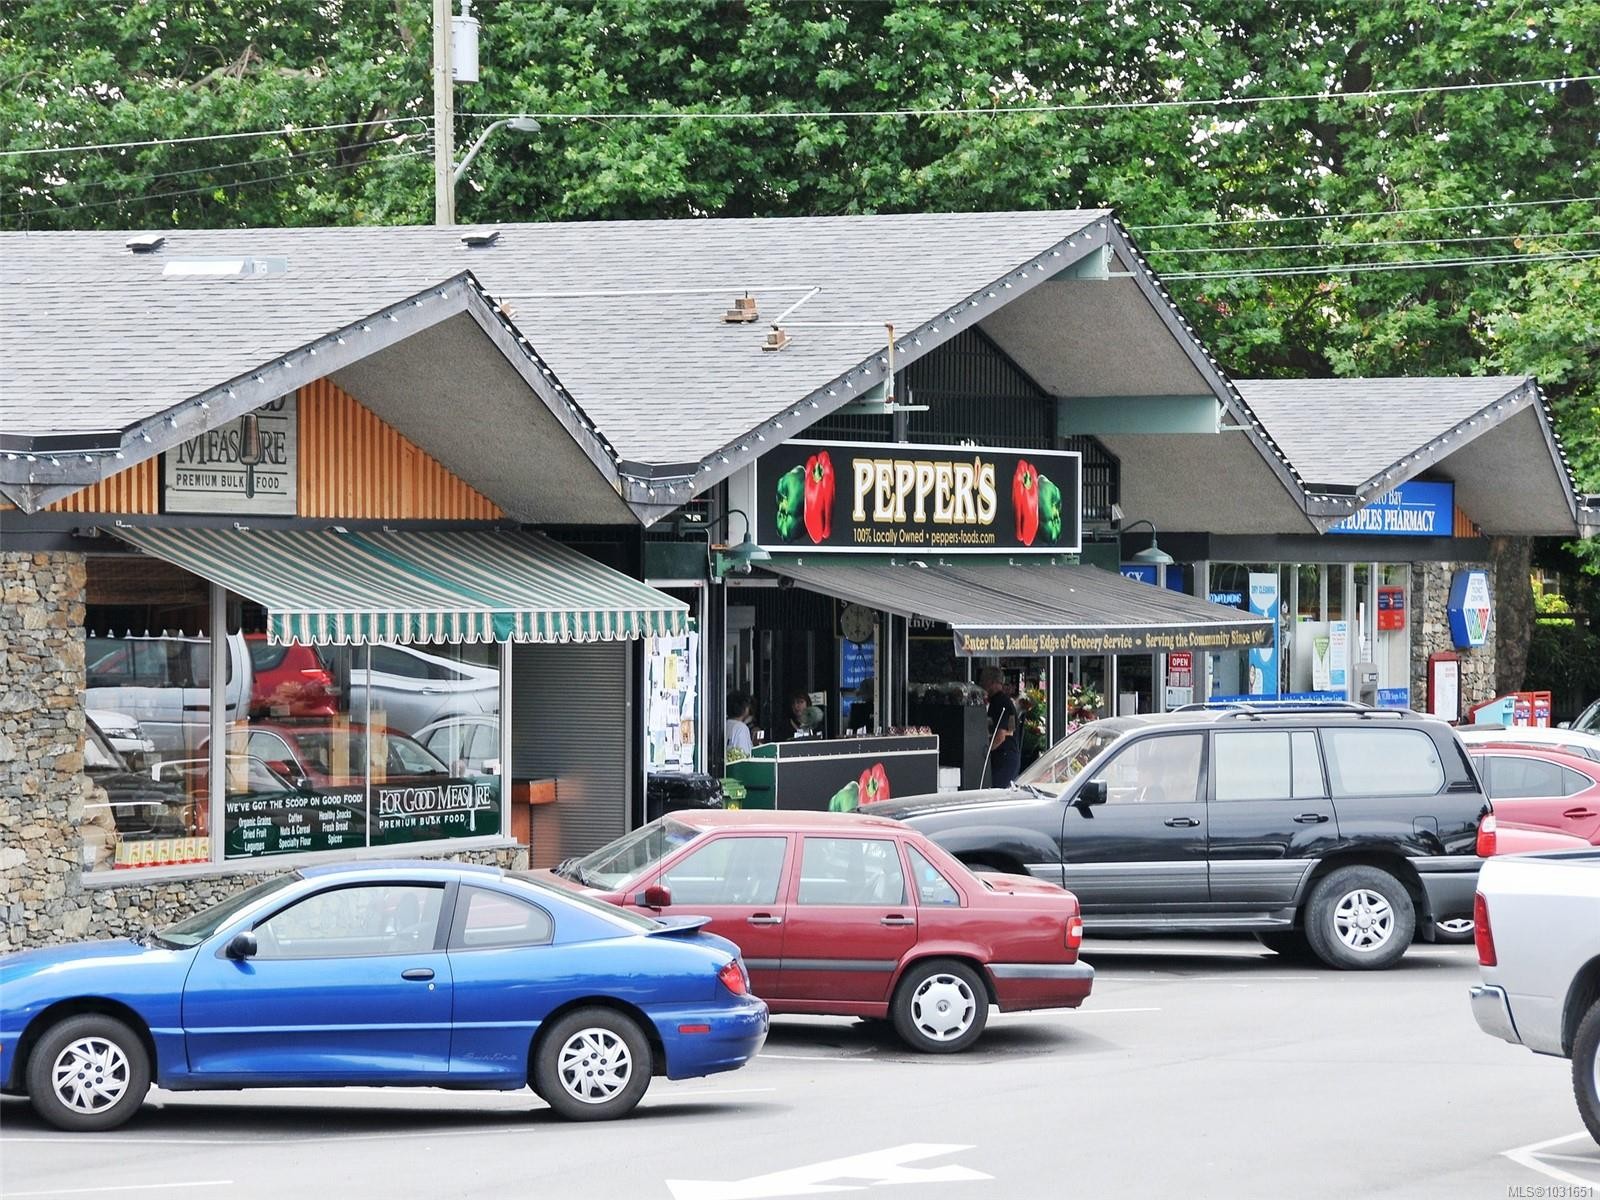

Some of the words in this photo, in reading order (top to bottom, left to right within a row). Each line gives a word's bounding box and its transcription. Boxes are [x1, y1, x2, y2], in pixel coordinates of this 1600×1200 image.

[176, 473, 217, 486] PREMIUM
[221, 475, 244, 488] BULK
[256, 476, 279, 489] FOOD
[852, 456, 997, 525] PEPPER'S
[1385, 510, 1435, 531] PHARMACY
[853, 528, 872, 542] 100%
[873, 529, 898, 545] Locally
[899, 529, 924, 543] Owned
[931, 530, 995, 546] peppers-foods.com
[964, 634, 989, 650] Enter
[990, 635, 1003, 648] the
[1006, 634, 1037, 652] Leading
[1039, 634, 1059, 651] Edge
[1061, 634, 1069, 648] of
[1071, 632, 1102, 651] Grocery
[1103, 633, 1132, 648] Service
[1146, 632, 1174, 650] Serving
[1176, 634, 1188, 646] the
[1189, 631, 1229, 647] Community
[1231, 630, 1250, 643] Since
[1172, 658, 1188, 666] OPEN
[227, 802, 250, 812] WE'VE
[252, 801, 267, 810] GOT
[270, 800, 283, 809] THE
[286, 798, 308, 808] SCOOP
[311, 797, 320, 805] ON
[323, 796, 341, 805] GOOD
[344, 794, 363, 803] FOOD!
[379, 790, 405, 818] FOR
[404, 788, 435, 811] GOOD
[288, 814, 303, 823] Coffee
[319, 811, 335, 821] Healthy
[336, 809, 352, 819] Snacks
[239, 818, 255, 828] Organic
[257, 816, 272, 826] Grains
[323, 823, 335, 832] Fresh
[336, 821, 348, 831] Bread
[379, 819, 416, 829] PREMIUM
[419, 816, 441, 826] BULK
[444, 814, 465, 823] FOOD
[243, 830, 255, 839] Dried
[256, 828, 267, 838] Fruit
[280, 827, 291, 835] Nuts
[297, 824, 310, 833] Cereal
[279, 838, 299, 849] Specialty
[300, 837, 311, 846] Flour
[328, 835, 342, 844] Spices
[245, 842, 265, 852] Legumes
